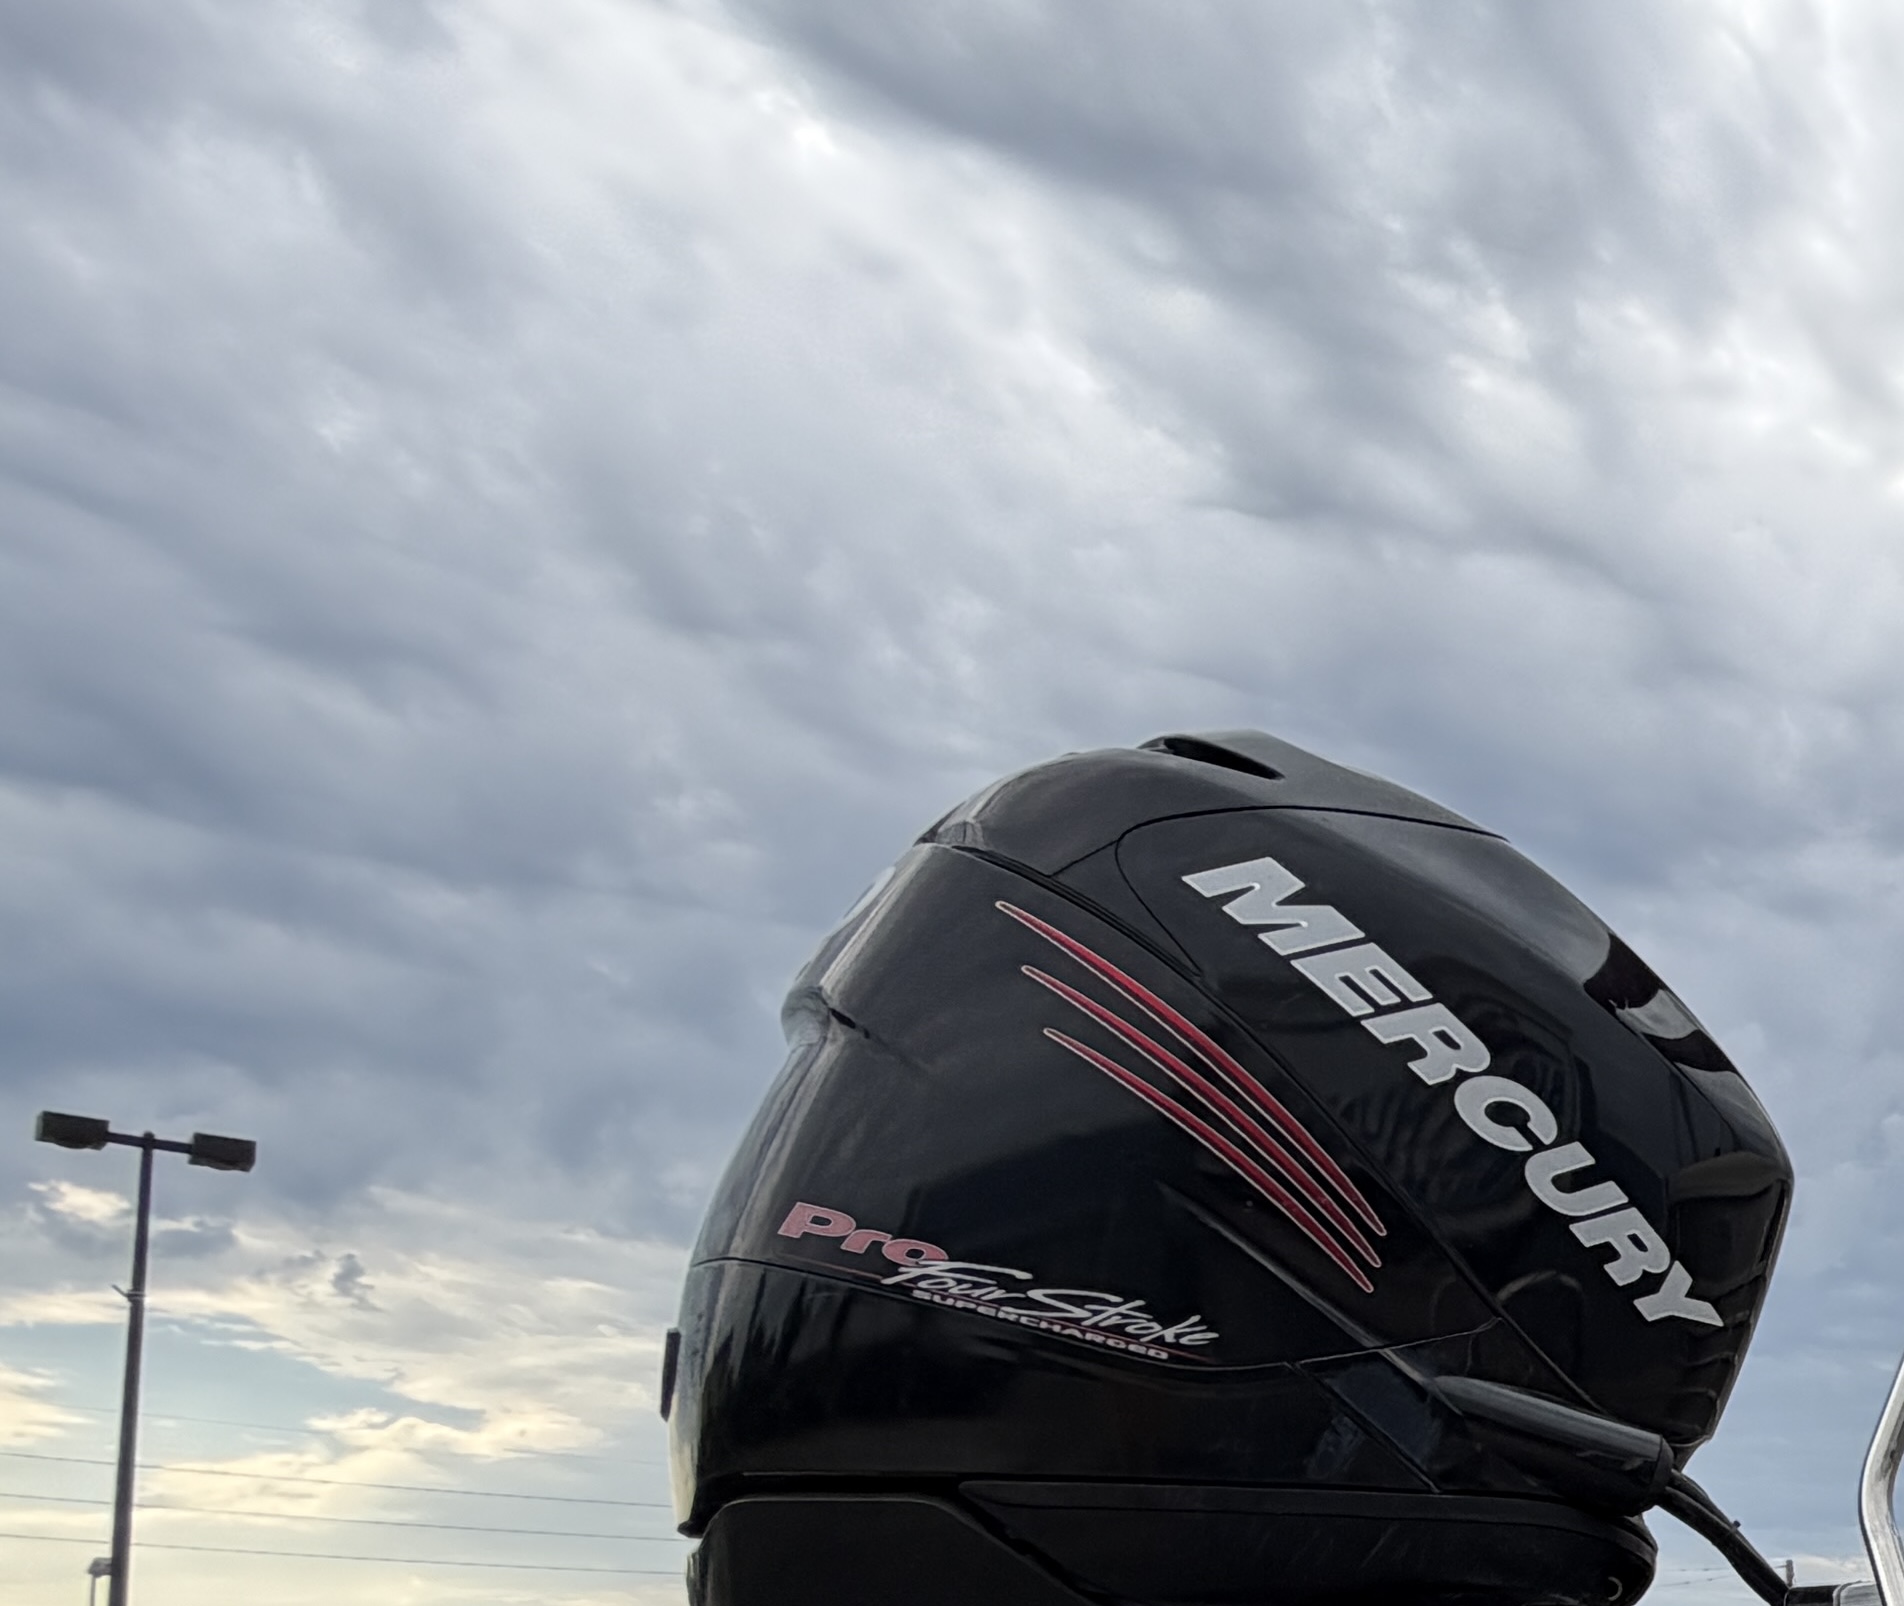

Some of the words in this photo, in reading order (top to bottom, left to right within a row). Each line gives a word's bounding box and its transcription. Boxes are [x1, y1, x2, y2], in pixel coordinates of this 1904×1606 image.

[1181, 856, 1724, 1329] MERCURY
[777, 1201, 949, 1267] Pro
[911, 1289, 1170, 1361] SUPERCHARGED
